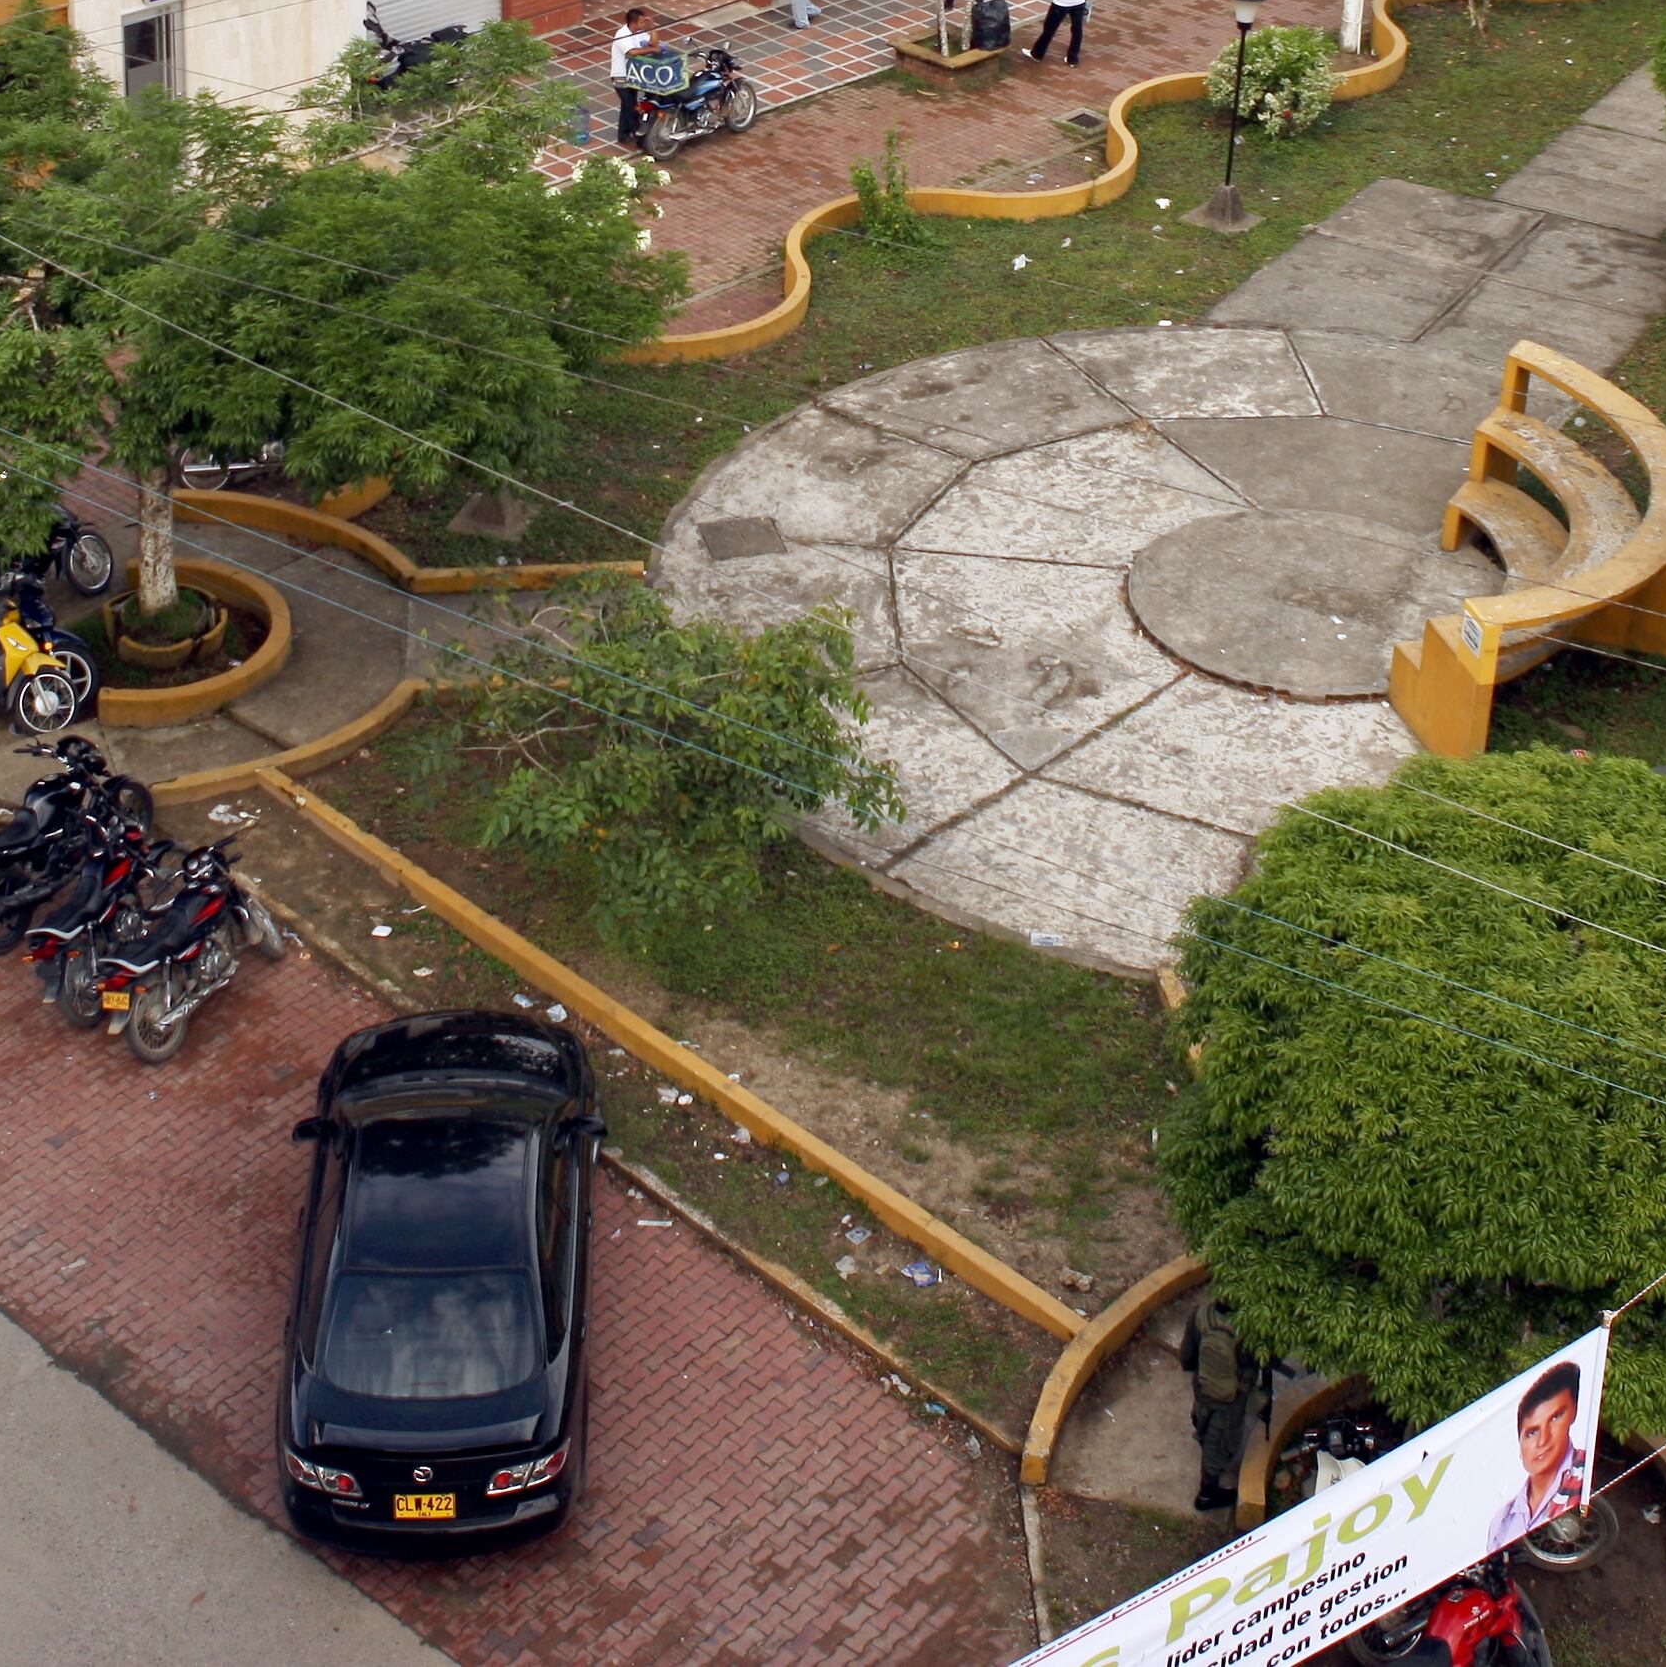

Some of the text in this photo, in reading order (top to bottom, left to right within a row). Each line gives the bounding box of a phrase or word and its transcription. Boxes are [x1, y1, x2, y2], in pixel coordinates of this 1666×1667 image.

[1166, 1452, 1454, 1646] Pajoy
[1282, 1609, 1312, 1635] de
[1319, 1554, 1408, 1619] gestion
[1166, 1630, 1225, 1667] lider
[1232, 1552, 1366, 1636] campesino
[1266, 1587, 1408, 1667] con todos...
